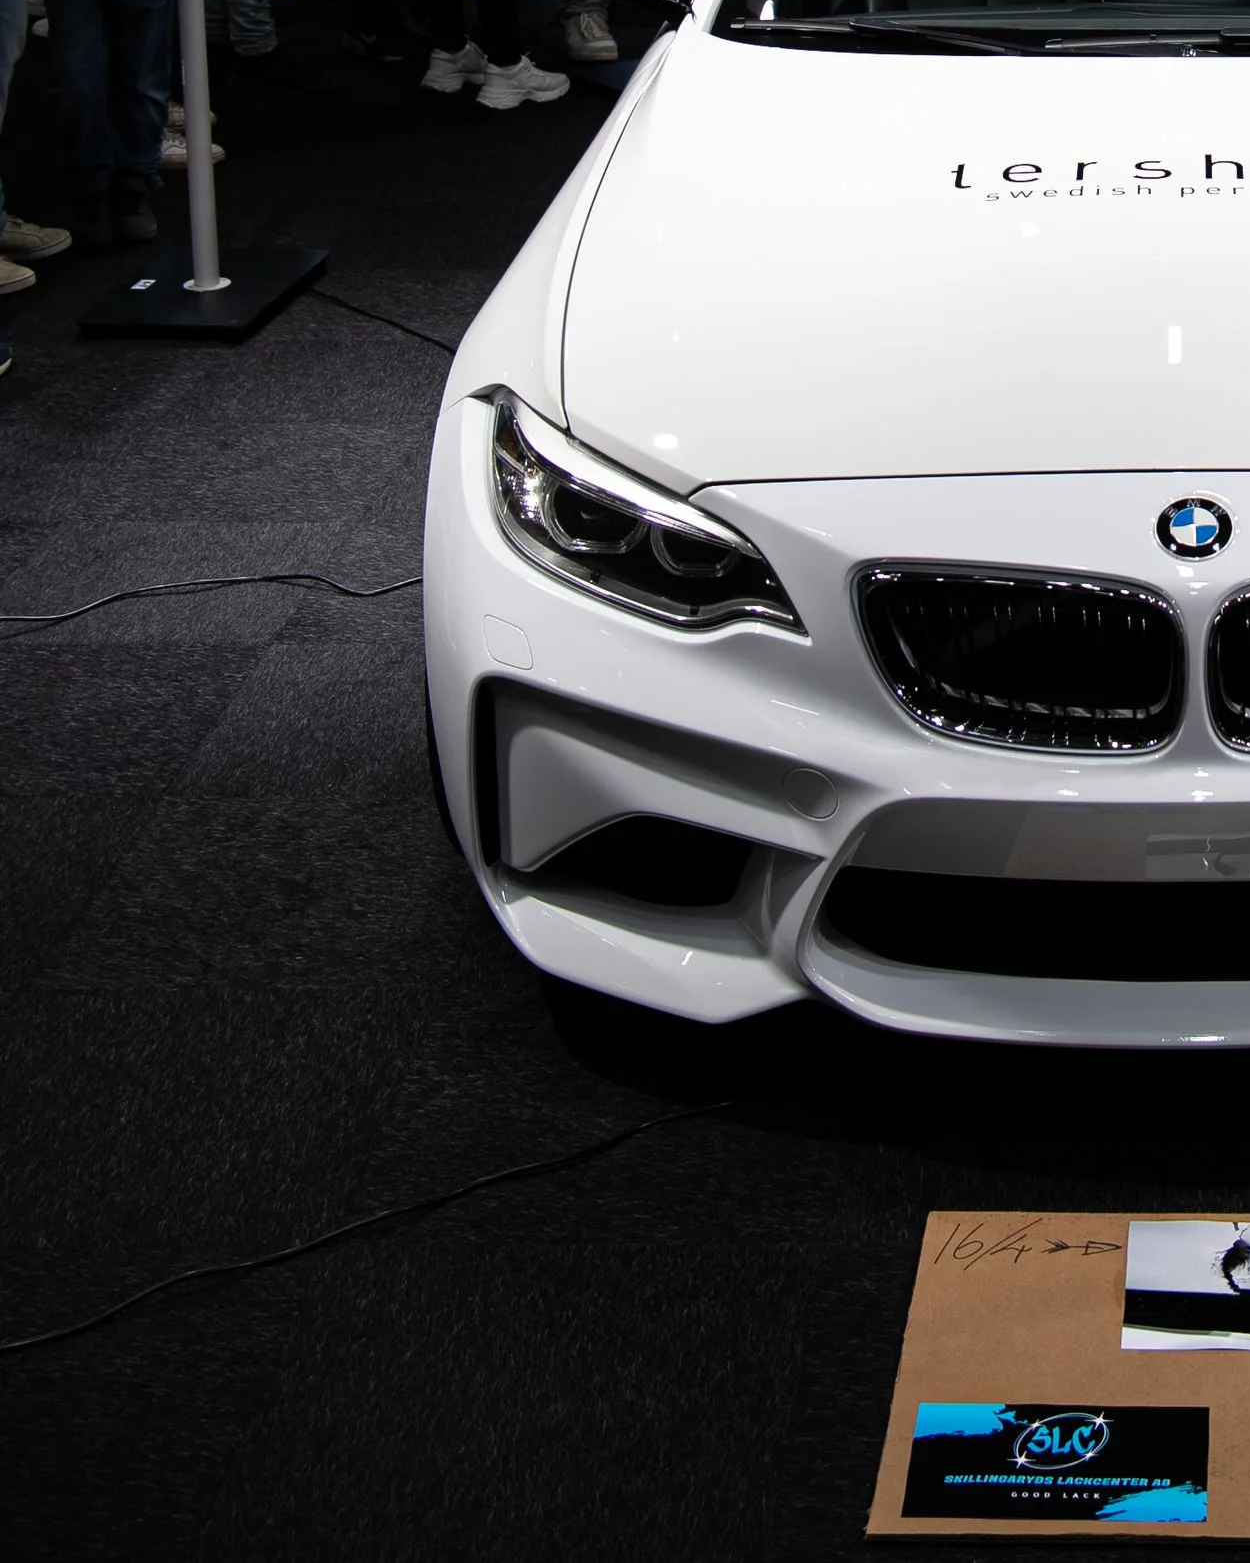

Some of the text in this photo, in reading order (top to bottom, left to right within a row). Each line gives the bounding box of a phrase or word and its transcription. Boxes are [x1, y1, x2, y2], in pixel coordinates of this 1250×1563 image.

[985, 183, 1153, 202] swedish
[934, 1218, 1043, 1271] 16/4
[1027, 1424, 1096, 1455] SLC
[1057, 1475, 1148, 1487] LACKCENTER
[1011, 1491, 1100, 1500] GOOD LACK
